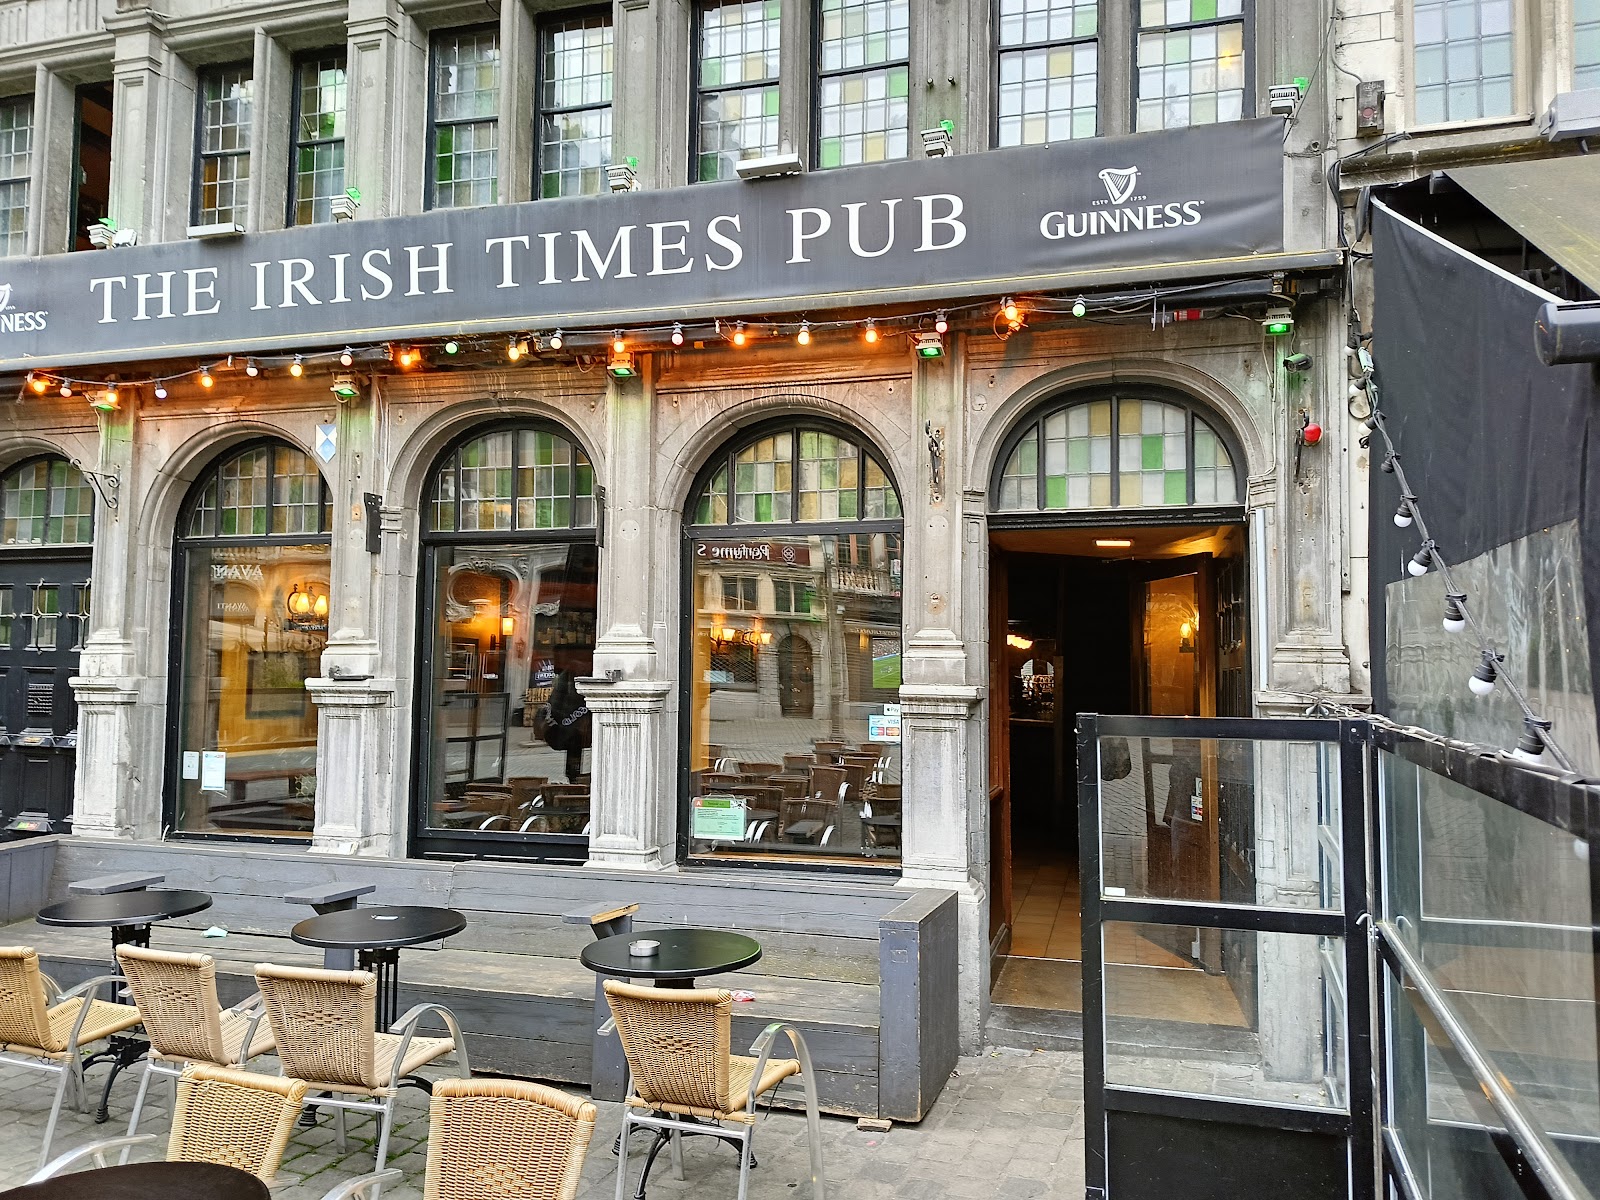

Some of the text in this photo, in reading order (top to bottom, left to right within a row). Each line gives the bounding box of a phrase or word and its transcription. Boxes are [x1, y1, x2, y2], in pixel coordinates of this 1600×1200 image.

[88, 193, 968, 325] THE IRISH TIMES PUB
[1039, 200, 1202, 240] GUINNESS
